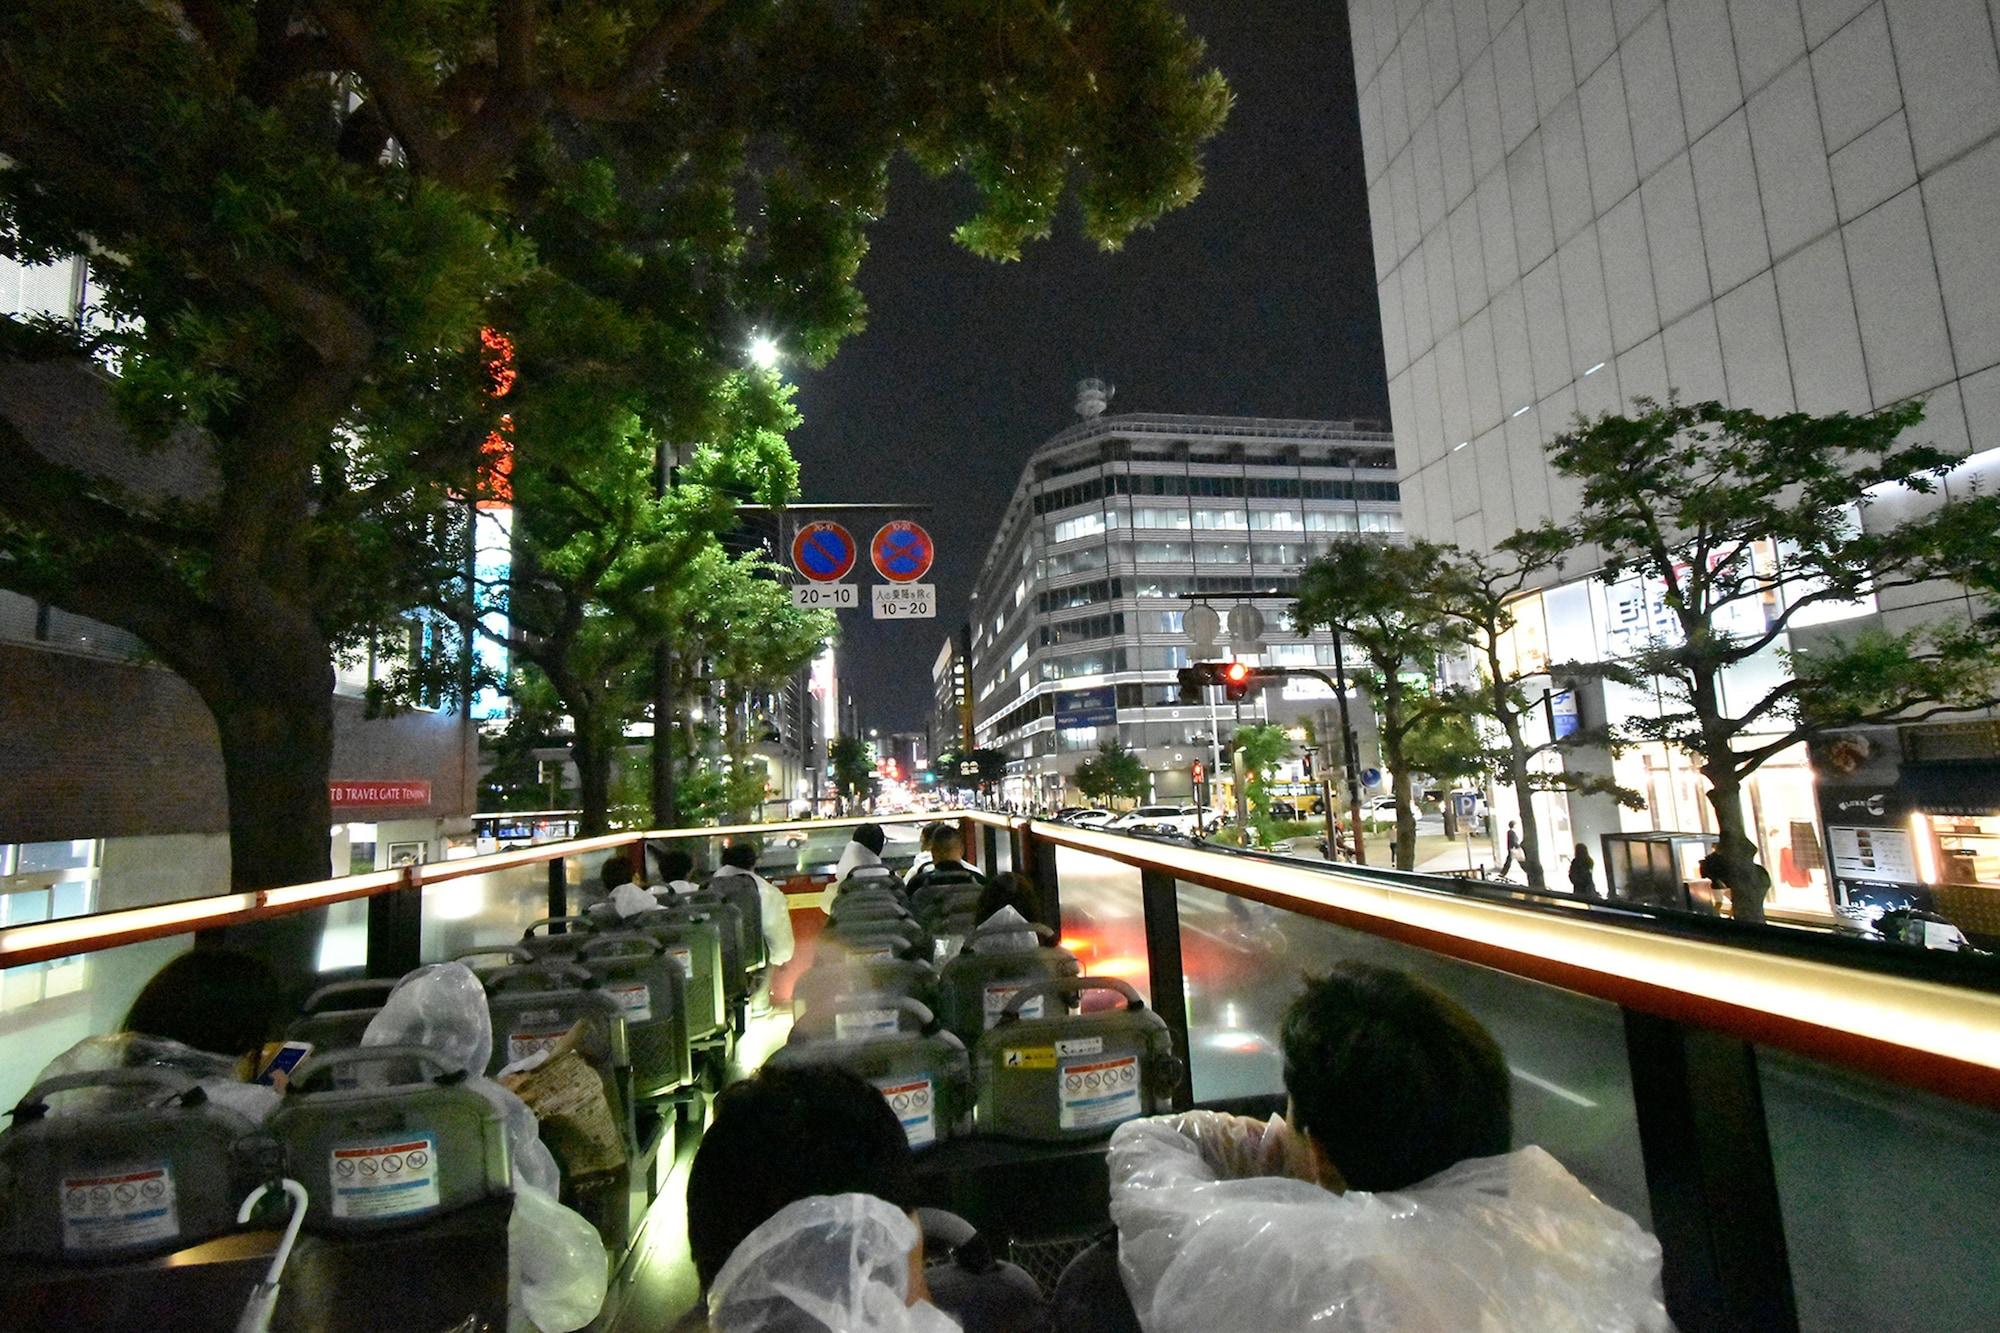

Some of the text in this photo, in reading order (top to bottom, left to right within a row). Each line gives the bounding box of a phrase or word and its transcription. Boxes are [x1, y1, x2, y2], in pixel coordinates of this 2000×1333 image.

[800, 589, 850, 604] 20-10
[882, 602, 927, 615] 10-20
[329, 787, 343, 801] TB
[346, 787, 379, 800] TRAVEL
[380, 787, 400, 799] GATE
[1461, 797, 1473, 814] P
